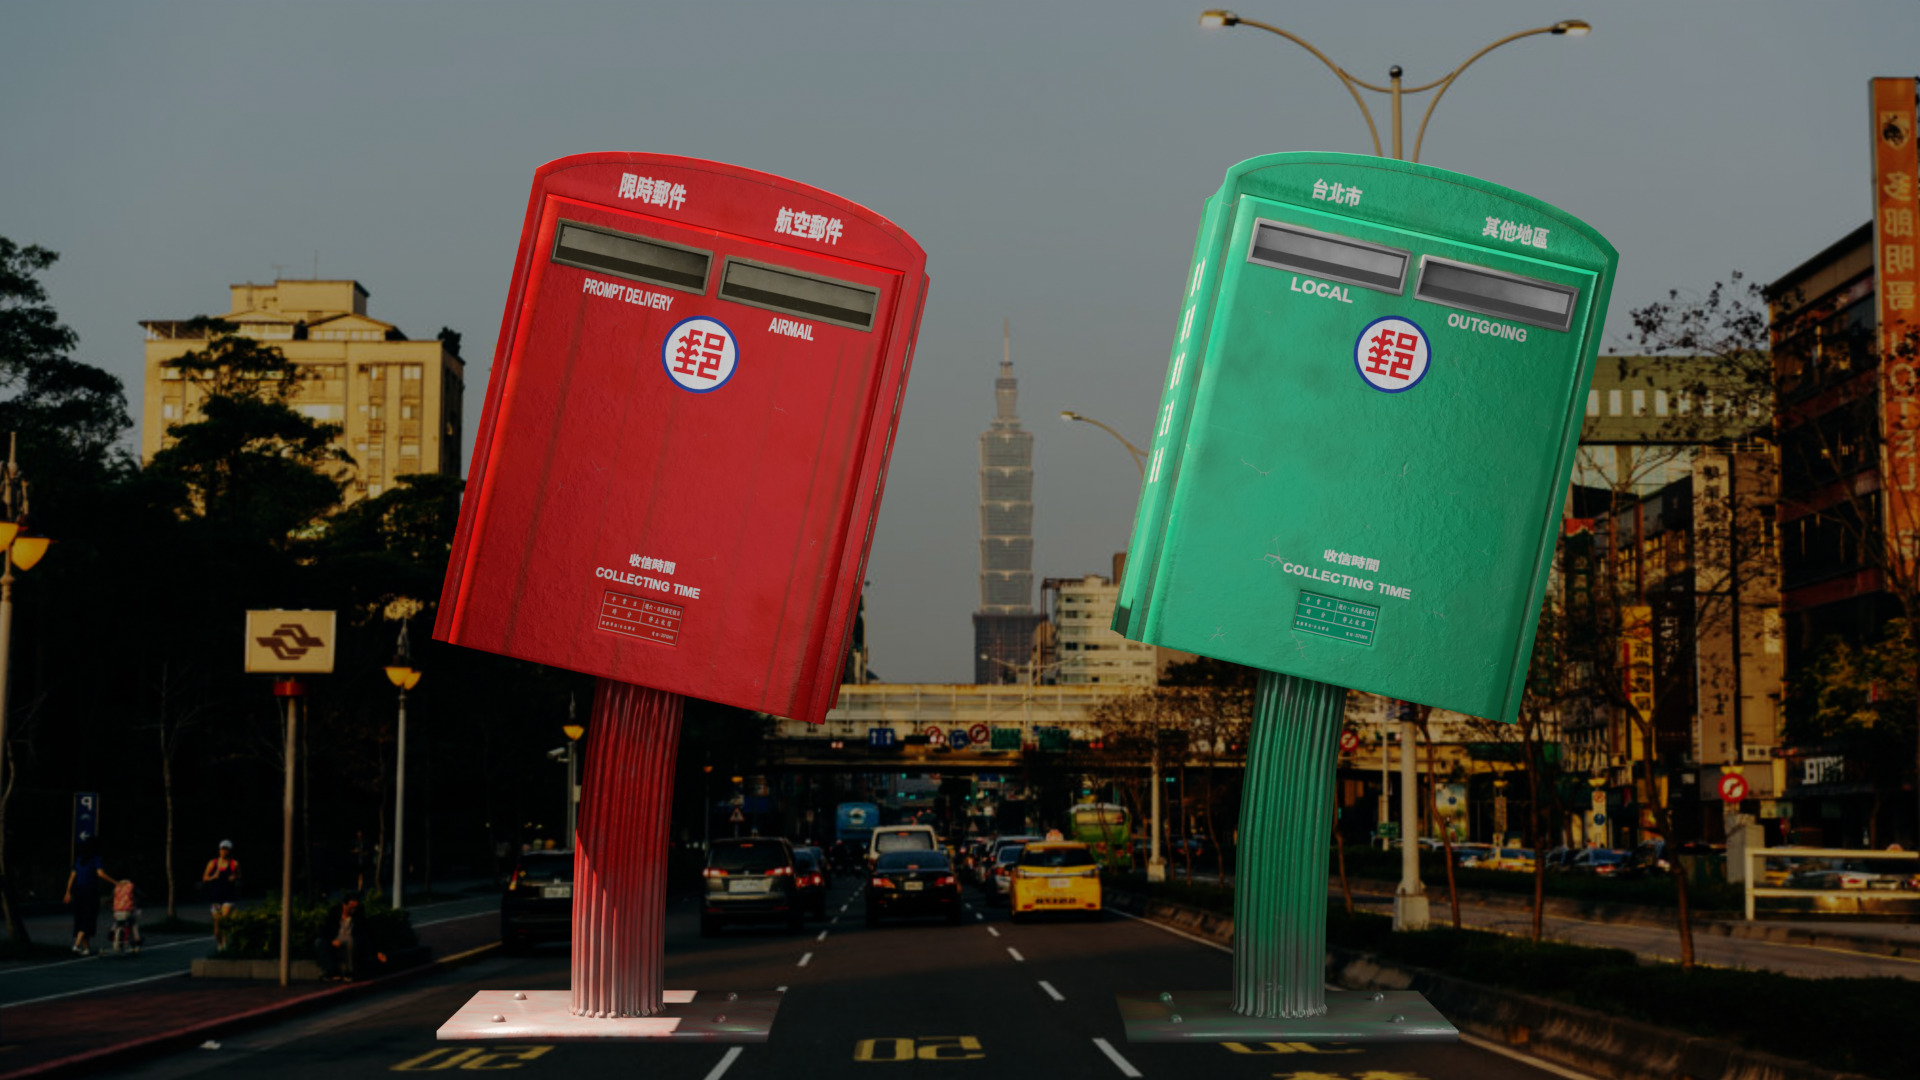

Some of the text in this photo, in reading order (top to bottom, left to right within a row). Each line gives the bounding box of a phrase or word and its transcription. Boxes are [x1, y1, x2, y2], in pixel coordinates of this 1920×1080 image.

[618, 172, 687, 210] 限時郵件
[1311, 178, 1363, 207] 台北市
[774, 206, 844, 245] 航空郵件
[1482, 216, 1550, 249] 其他地區
[582, 278, 674, 311] PROMPT DELIVERY
[1290, 276, 1353, 303] LOCAL
[768, 317, 814, 341] AIRMAIL
[1447, 313, 1528, 342] OUTGOING
[629, 553, 676, 575] 收信時間
[1323, 549, 1380, 572] 收信時間
[595, 567, 701, 599] COLLECTING TIME
[1283, 562, 1411, 600] COLLECTING TIME
